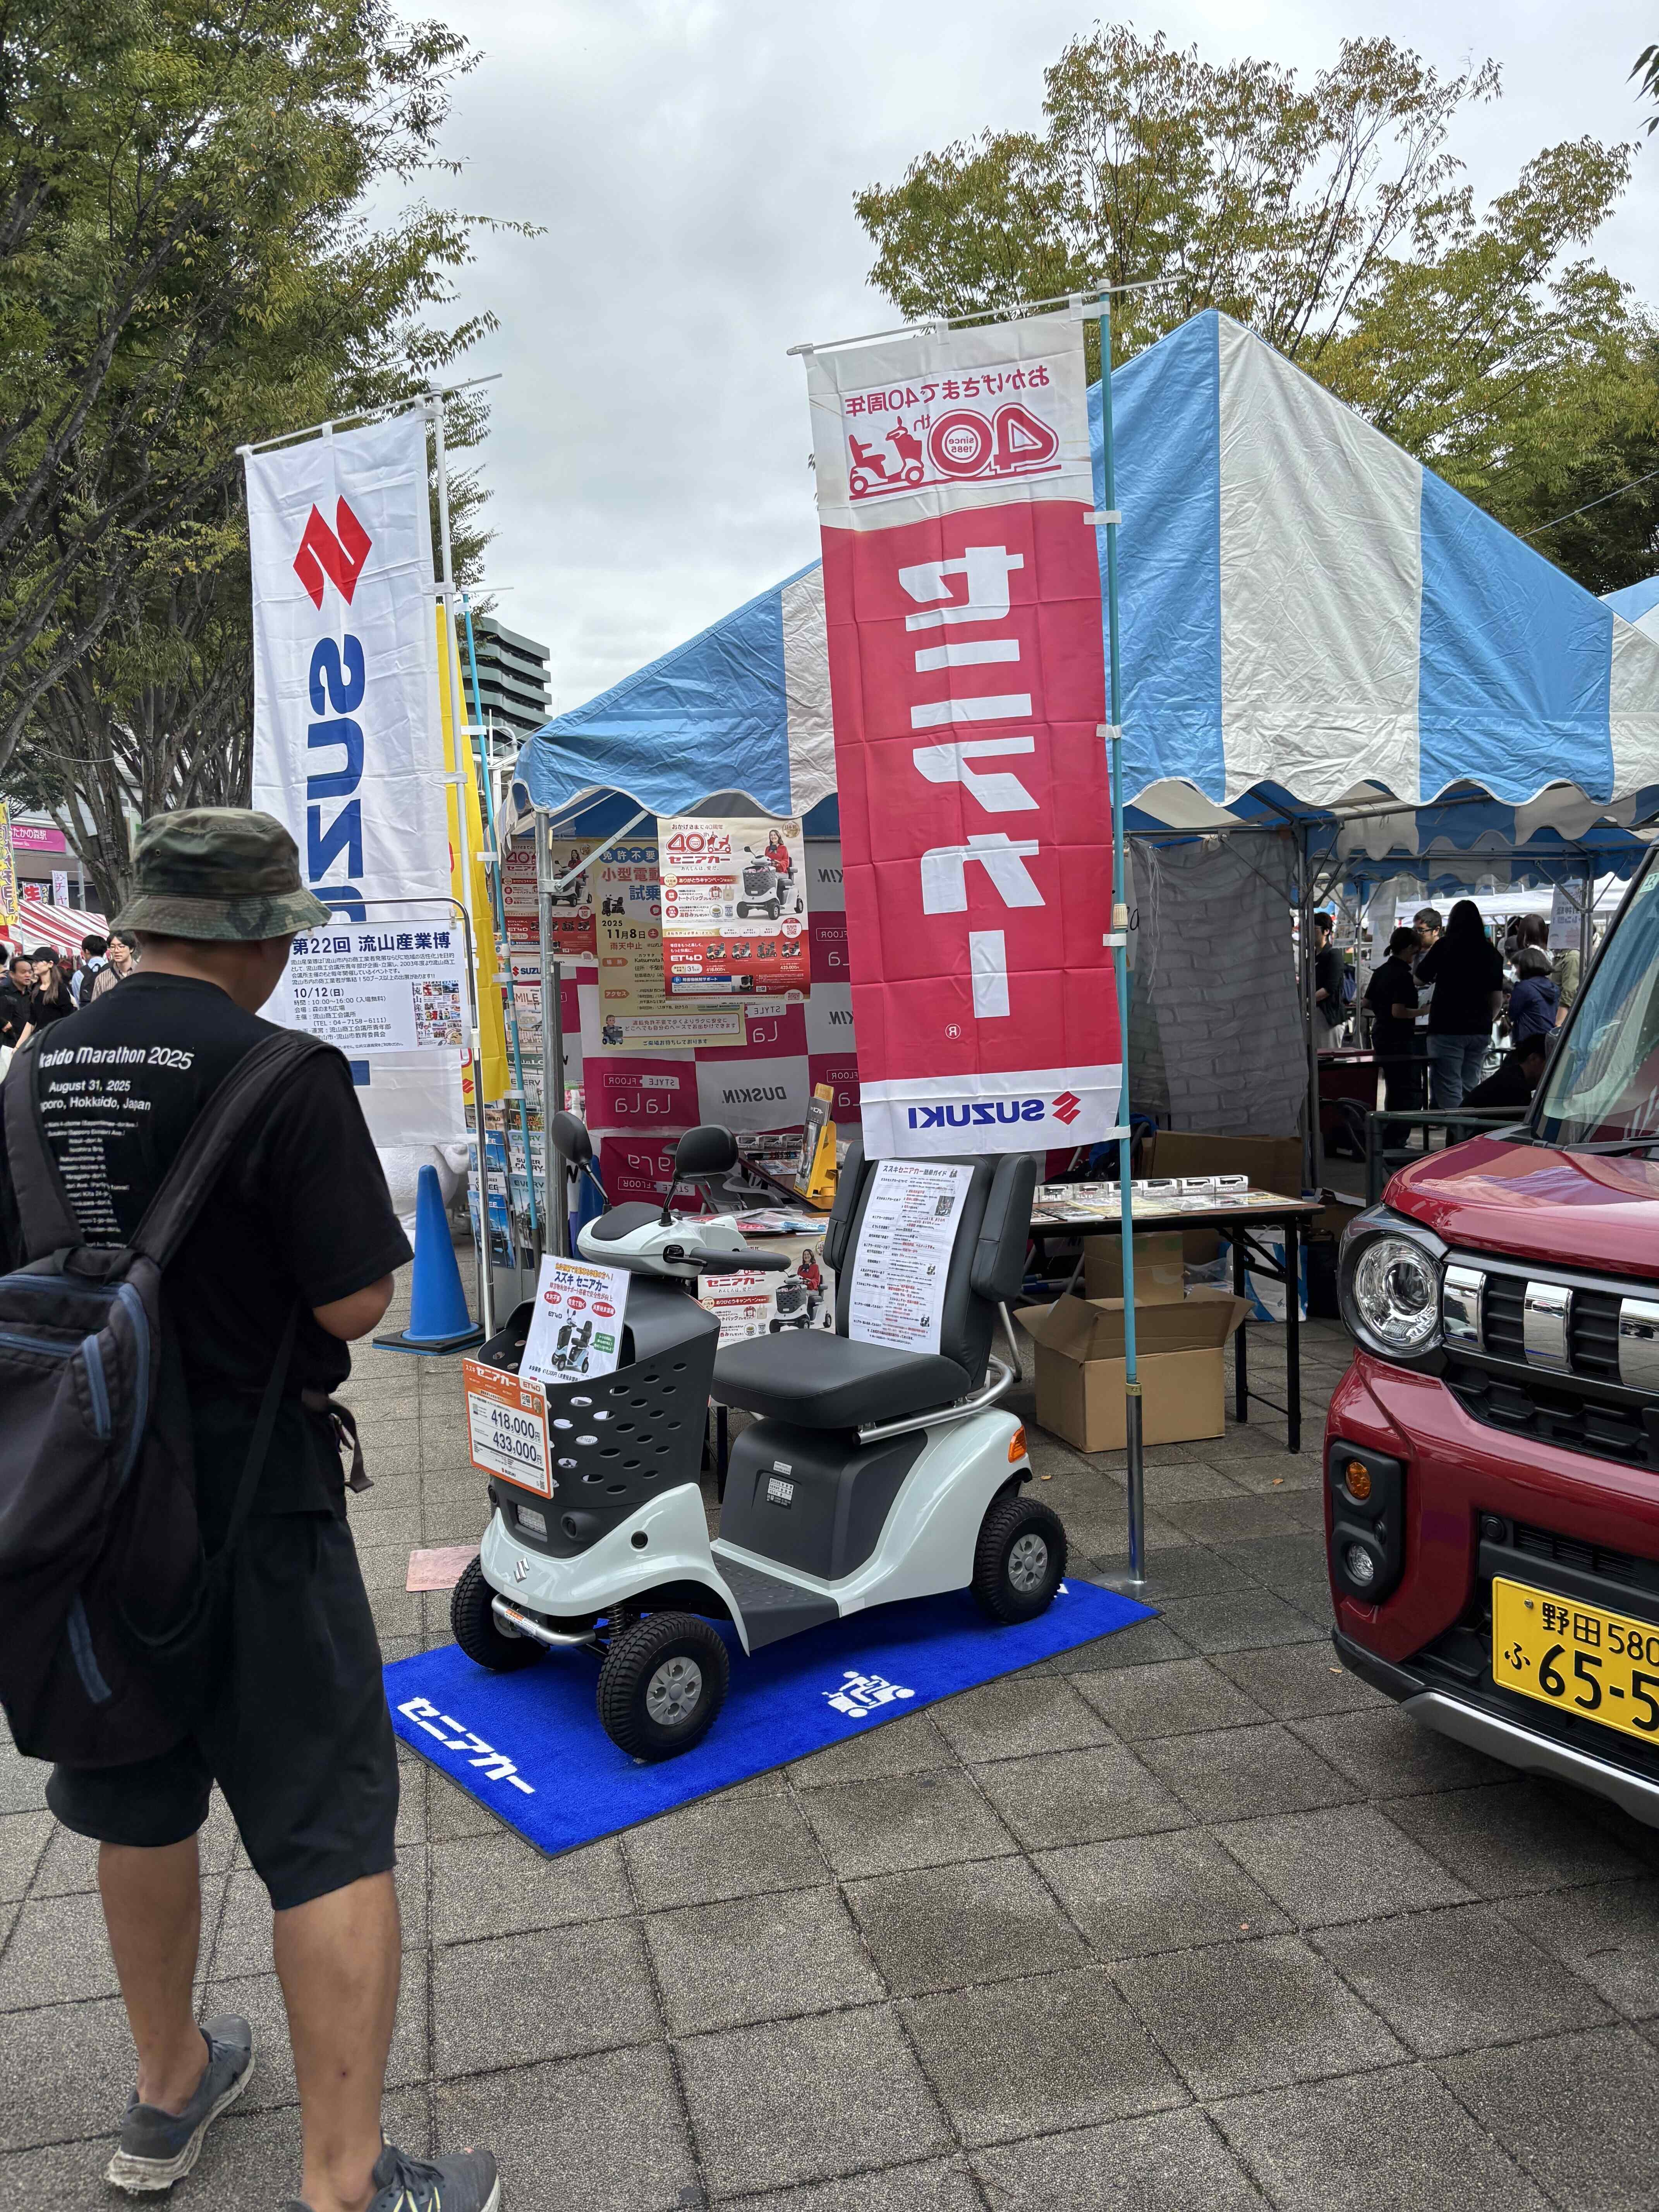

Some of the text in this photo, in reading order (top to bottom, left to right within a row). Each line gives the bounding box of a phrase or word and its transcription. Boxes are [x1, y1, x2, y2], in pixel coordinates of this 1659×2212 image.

[603, 850, 655, 860] 免許不要
[668, 855, 730, 864] セニアカー
[602, 867, 660, 882] 小型電動
[607, 929, 646, 939] 11月8日
[292, 932, 451, 955] 第22回 流山産業博
[610, 942, 643, 950] 雨天中止
[515, 993, 539, 1003] MILE
[40, 1047, 195, 1070] kaido Marathon 2025
[49, 1080, 131, 1093] August 31, 2025
[40, 1097, 151, 1113] poro, Hokkaido, Japan
[515, 1163, 543, 1173] CARY
[554, 1271, 574, 1286] スズキ
[576, 1275, 609, 1292] セニアカー
[706, 1278, 765, 1288] セニアカー
[465, 1364, 517, 1386] スズキ セニアカー
[491, 1409, 541, 1442] 418,000円
[493, 1431, 542, 1465] 433,000円
[1542, 1601, 1659, 1666] 野田 580
[1504, 1642, 1530, 1670] ふ
[397, 1697, 535, 1794] セニアカー
